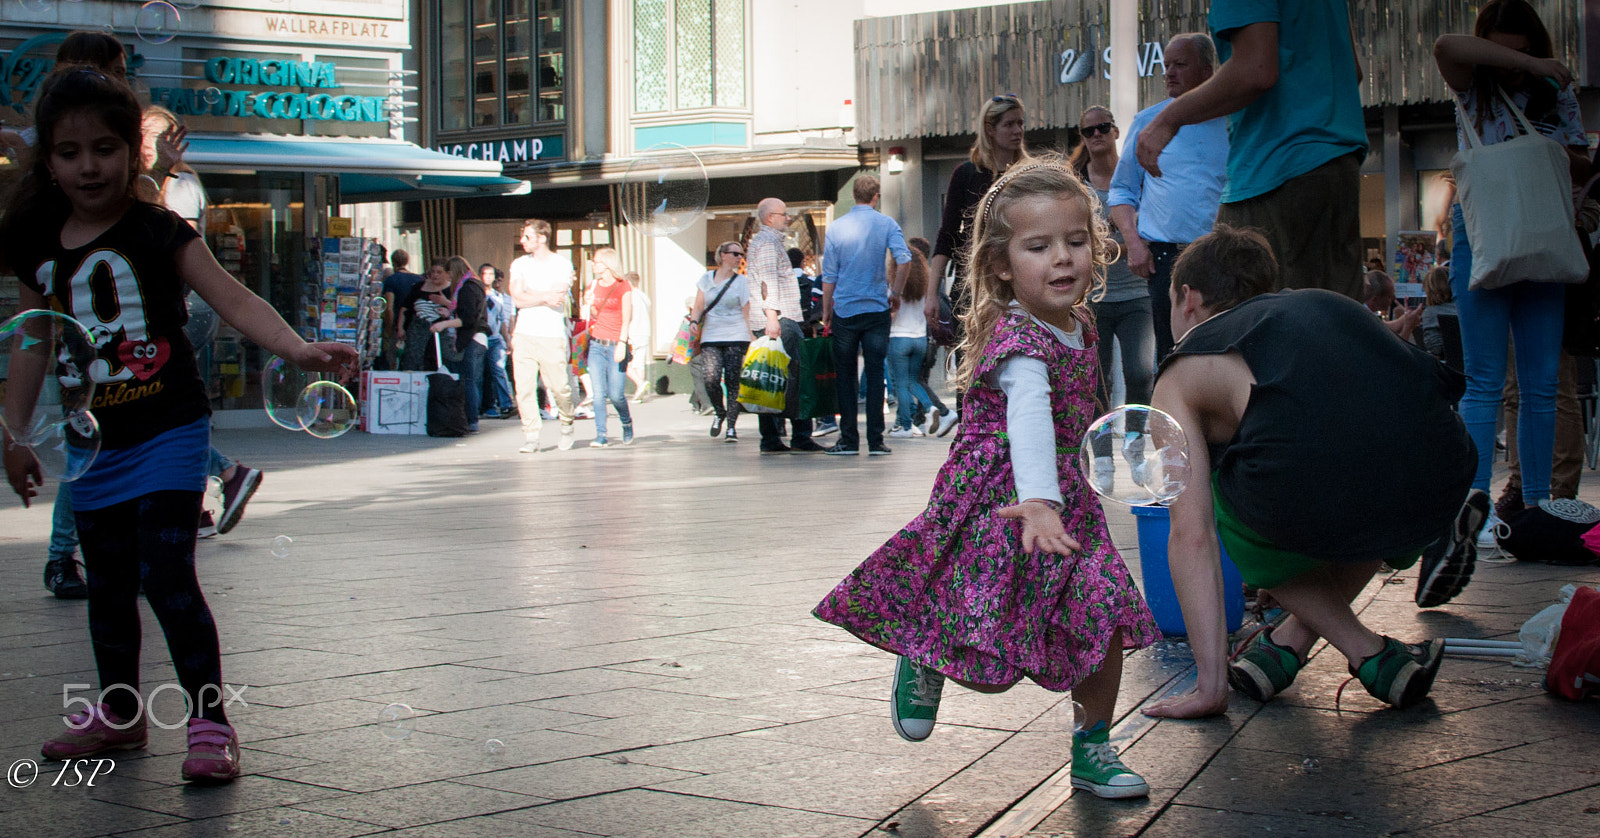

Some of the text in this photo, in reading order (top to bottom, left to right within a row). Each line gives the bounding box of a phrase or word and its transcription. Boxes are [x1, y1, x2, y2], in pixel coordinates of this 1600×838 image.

[265, 17, 389, 38] WALLRAFPLATZ
[204, 56, 341, 88] ORIGINAL
[253, 91, 389, 122] COLOGNE
[425, 139, 543, 162] GCHAMP
[91, 380, 164, 409] chland
